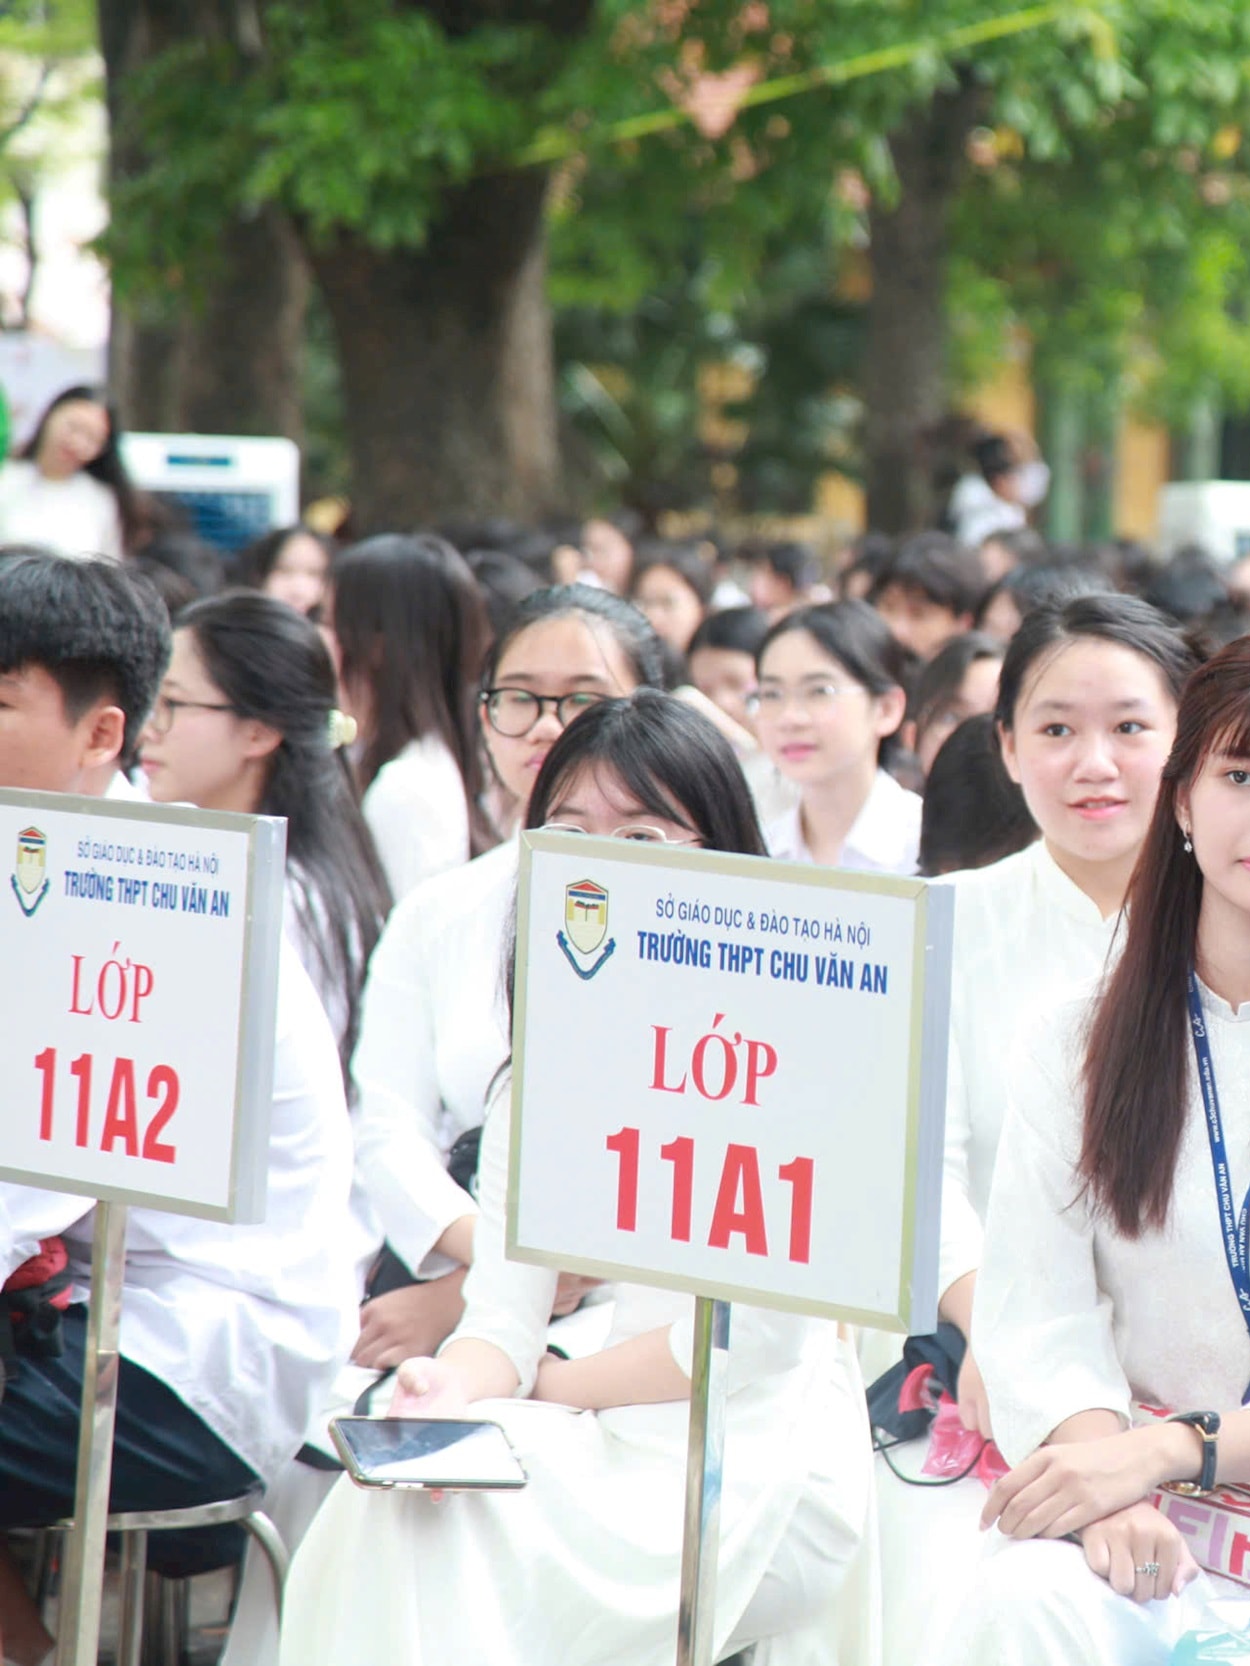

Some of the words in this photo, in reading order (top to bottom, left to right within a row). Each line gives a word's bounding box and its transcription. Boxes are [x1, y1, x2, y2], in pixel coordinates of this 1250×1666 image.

[64, 867, 114, 901] TRƯỜNG
[117, 877, 149, 906] THPT
[152, 882, 178, 910] CHU
[181, 882, 208, 914] VĂN
[210, 890, 230, 917] AN
[655, 893, 675, 919] SỞ
[678, 899, 711, 924] GIÁO
[714, 906, 742, 931] DỤC
[746, 911, 756, 930] &
[760, 909, 789, 935] ĐÀO
[793, 917, 820, 941] TẠO
[824, 917, 842, 943] HÀ
[847, 921, 871, 949] NỘI
[68, 941, 155, 1023] LỚP
[637, 929, 712, 969] TRƯỜNG
[717, 942, 765, 976] THPT
[770, 949, 809, 983] CHU
[815, 951, 854, 989] VĂN
[859, 962, 888, 995] AN
[647, 1012, 778, 1107] LỚP
[33, 1046, 181, 1164] 11A2
[605, 1126, 814, 1264] 11A1
[1218, 1163, 1226, 1175] AN
[1221, 1194, 1231, 1210] CHU
[1223, 1212, 1234, 1232] THPT
